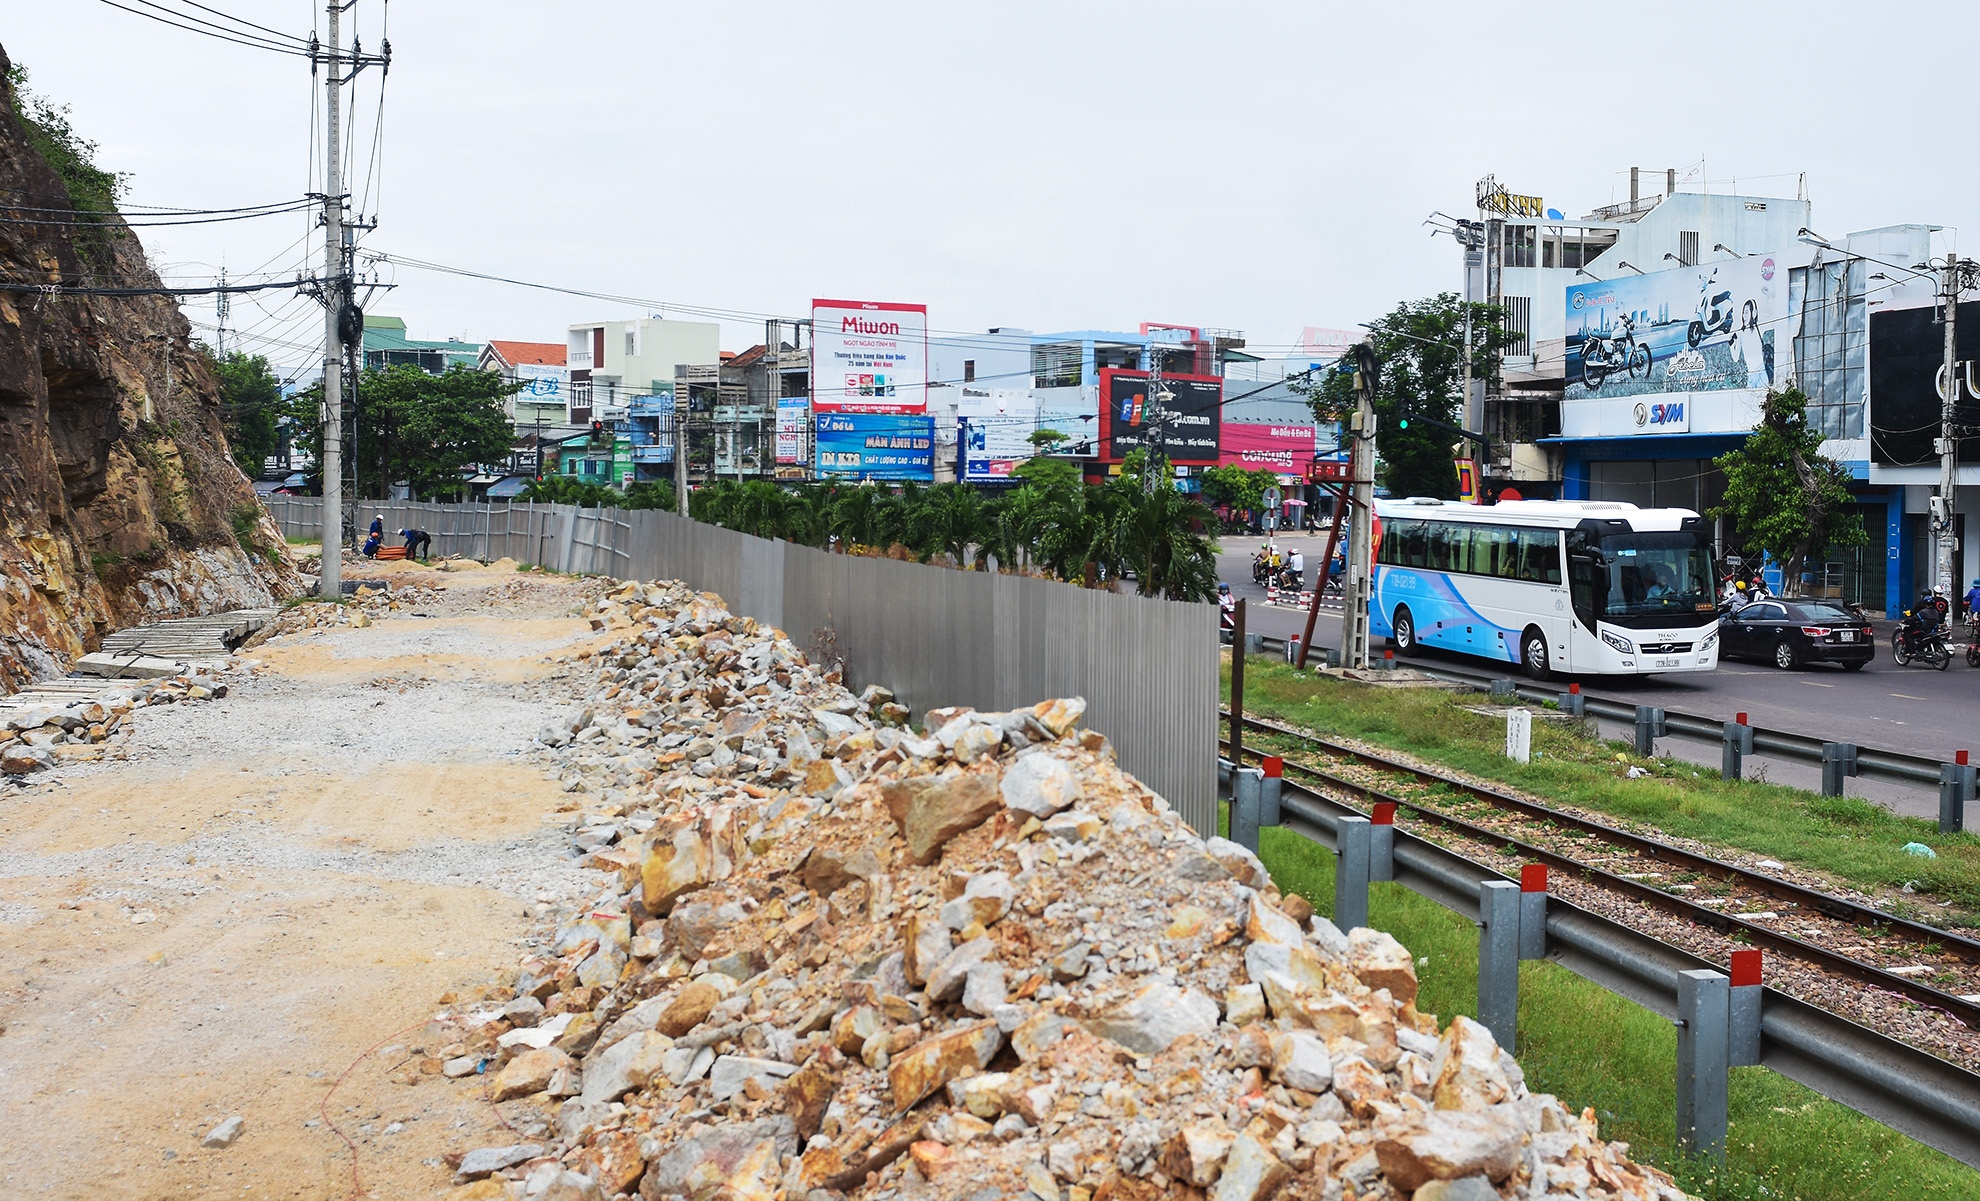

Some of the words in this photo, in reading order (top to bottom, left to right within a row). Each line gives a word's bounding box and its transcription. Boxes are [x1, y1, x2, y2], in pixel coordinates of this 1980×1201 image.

[842, 316, 899, 335] Miwon
[1650, 402, 1684, 425] SYM
[779, 433, 796, 441] NGH
[1291, 428, 1295, 437] &
[865, 434, 888, 448] MÀN
[913, 438, 930, 449] LED
[821, 452, 835, 466] IN
[837, 453, 860, 466] KTS
[865, 456, 878, 464] CHẤT
[898, 457, 908, 465] CAO
